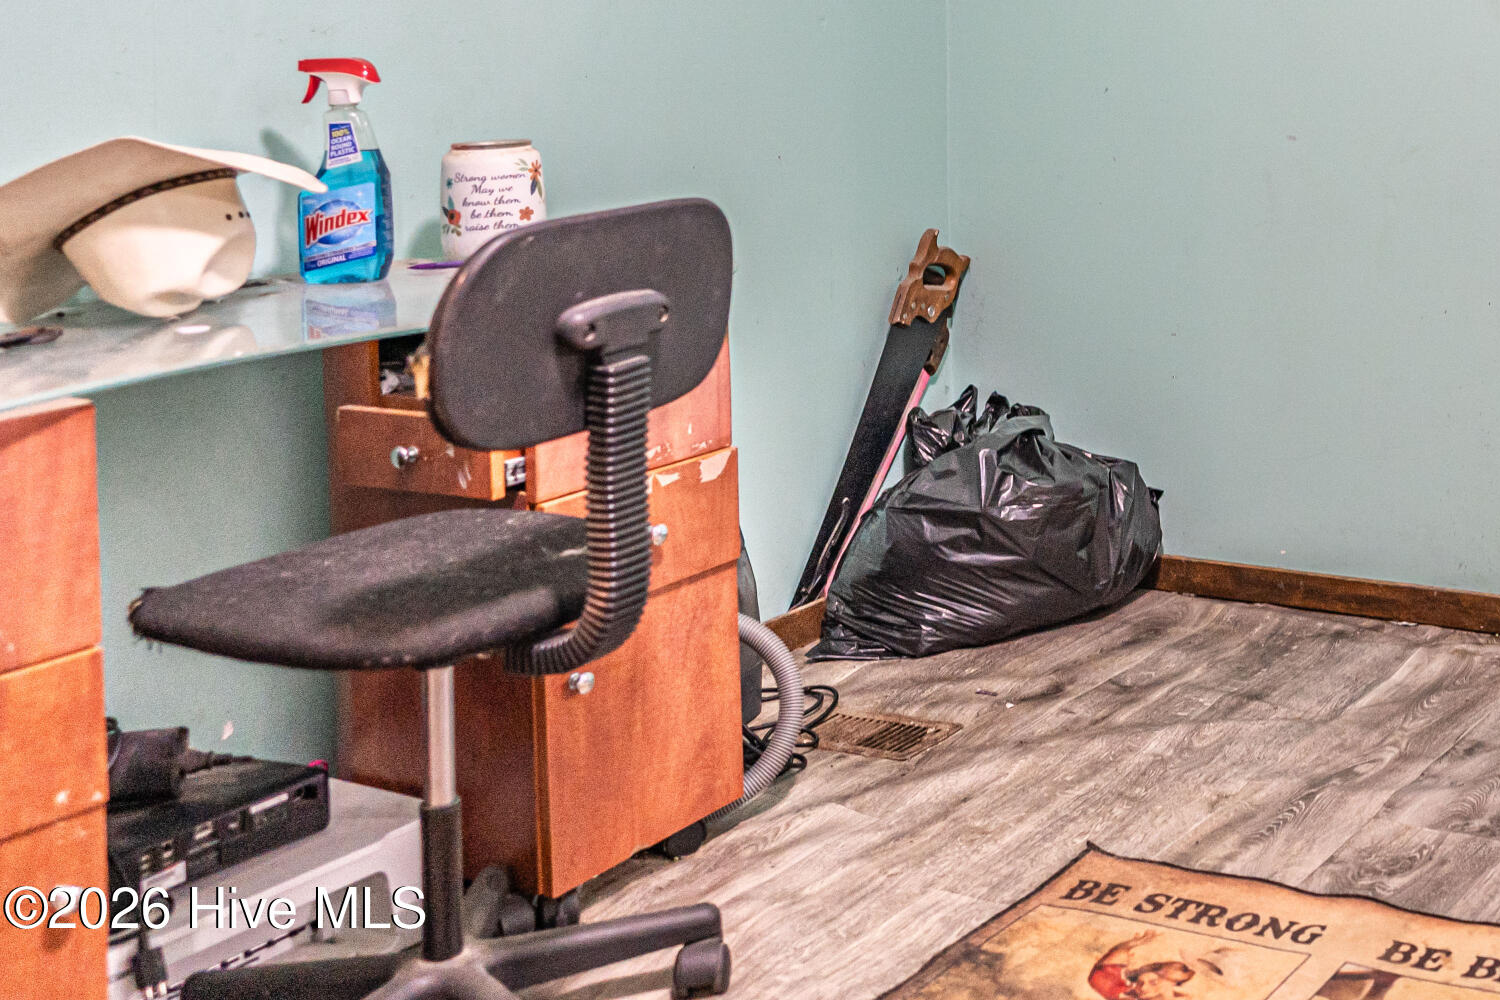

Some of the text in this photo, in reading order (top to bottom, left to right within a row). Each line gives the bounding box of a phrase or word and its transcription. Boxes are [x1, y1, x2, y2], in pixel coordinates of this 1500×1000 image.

[454, 172, 487, 185] Strong
[471, 184, 494, 195] May
[470, 209, 481, 219] be
[305, 208, 370, 247] Windex
[1059, 879, 1327, 946] BE STRONG
[1376, 939, 1453, 973] BE
